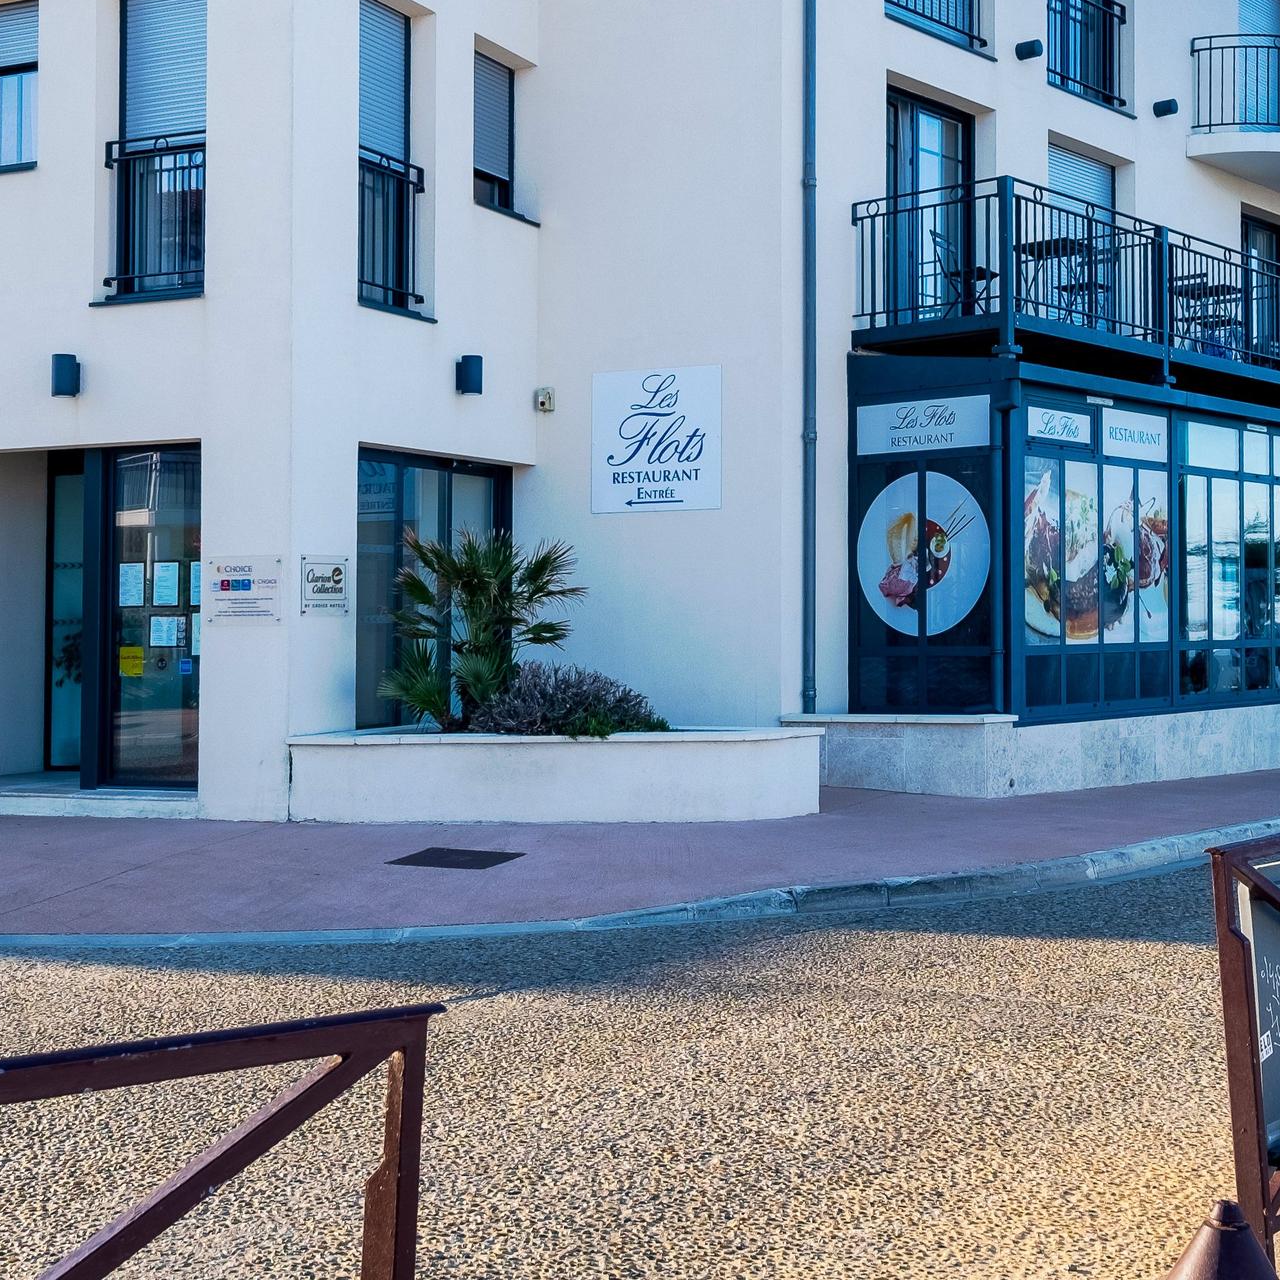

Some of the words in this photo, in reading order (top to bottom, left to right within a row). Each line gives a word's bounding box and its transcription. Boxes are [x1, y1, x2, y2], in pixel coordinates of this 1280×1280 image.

[630, 374, 680, 410] Les
[889, 406, 919, 431] Les
[919, 404, 956, 428] Flots
[1037, 411, 1056, 436] Les
[1056, 415, 1080, 439] Flots
[606, 411, 706, 467] Flots
[889, 432, 955, 448] RESTAURANT
[1108, 425, 1161, 447] RESTAURANT
[612, 468, 701, 485] RESTAURANT
[224, 565, 253, 573] CHOICE
[306, 568, 332, 584] Clarion
[312, 584, 344, 594] Collection
